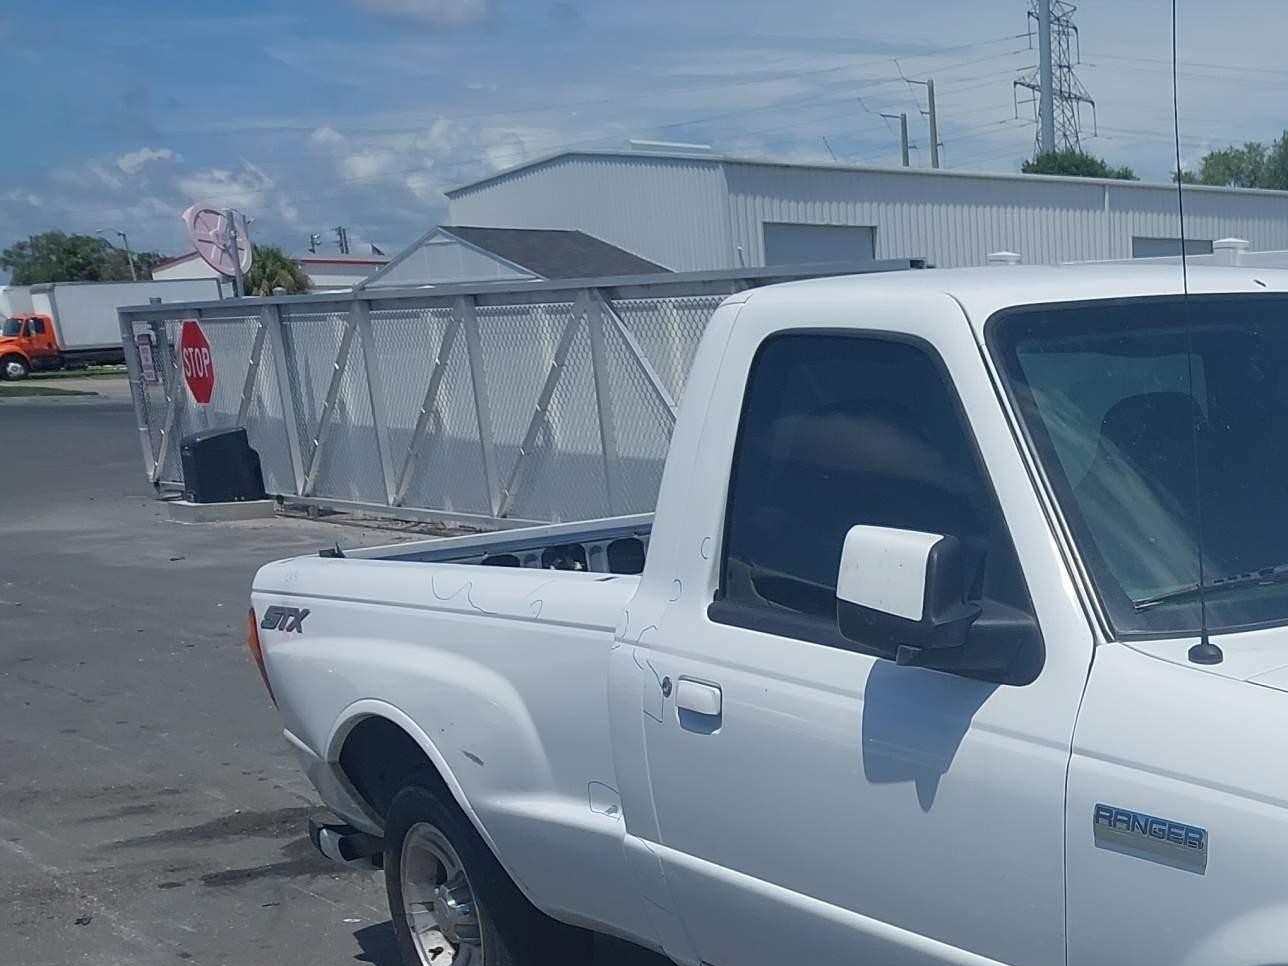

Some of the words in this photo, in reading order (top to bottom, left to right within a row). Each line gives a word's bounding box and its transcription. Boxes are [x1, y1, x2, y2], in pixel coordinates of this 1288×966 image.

[183, 347, 210, 378] STOP
[261, 605, 311, 634] STX
[1095, 805, 1205, 850] RANGER
